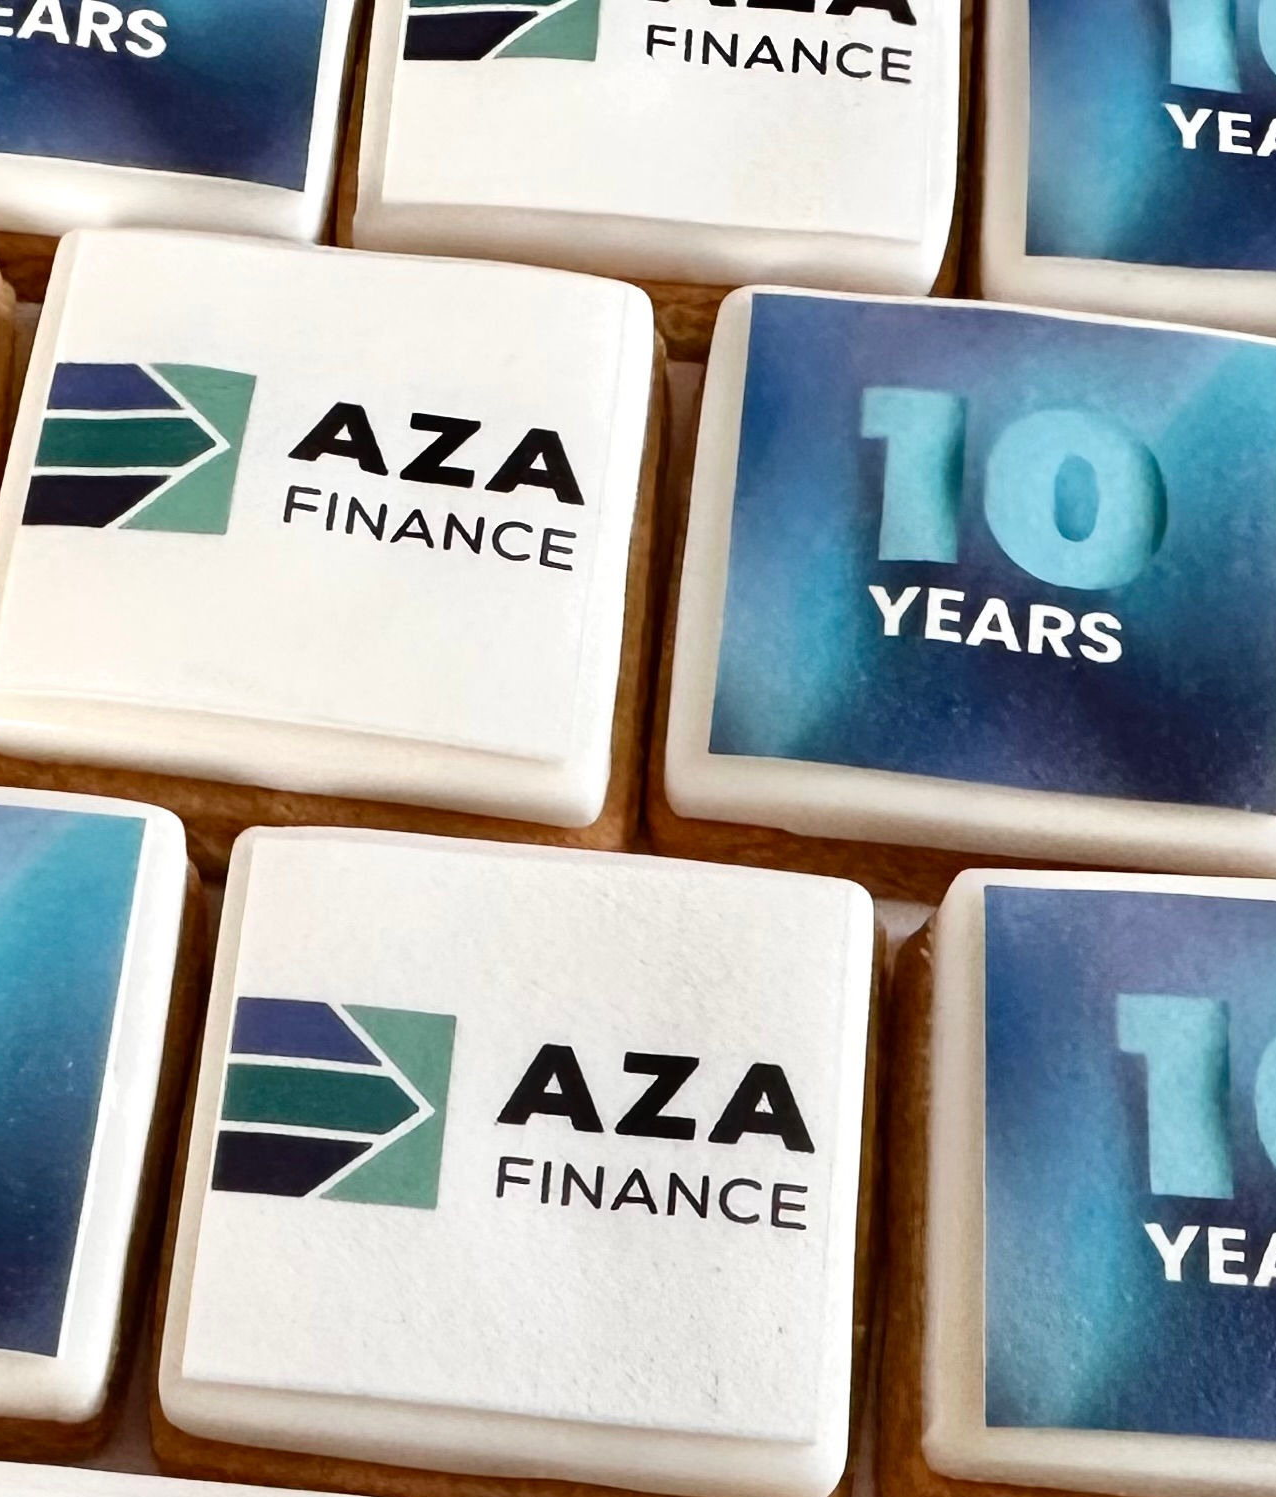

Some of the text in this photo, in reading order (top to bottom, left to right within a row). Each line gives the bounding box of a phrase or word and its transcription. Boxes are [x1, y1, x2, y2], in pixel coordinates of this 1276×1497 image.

[646, 24, 912, 84] FINANCE
[287, 401, 585, 506] AZA
[860, 386, 1167, 590] 10
[283, 485, 577, 571] FINANCE
[868, 585, 1122, 663] YEARS
[496, 1043, 815, 1154] AZA
[496, 1156, 808, 1231] FINANCE
